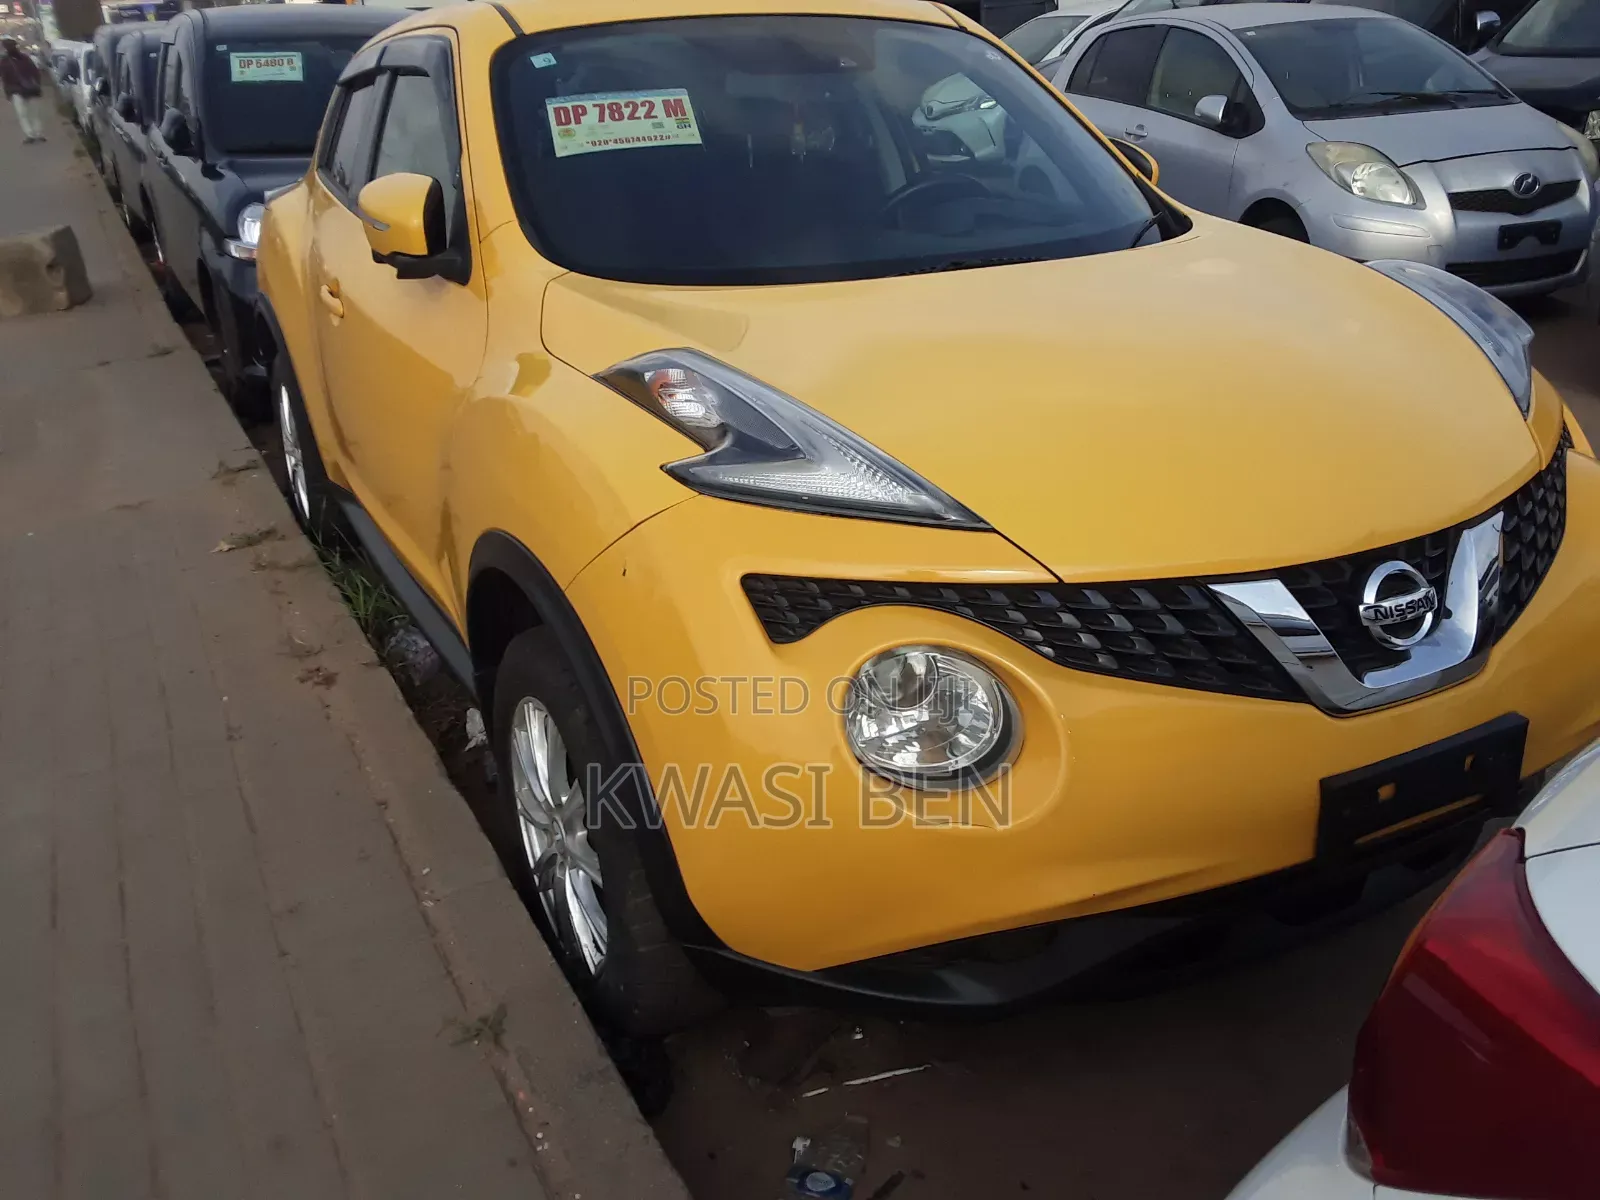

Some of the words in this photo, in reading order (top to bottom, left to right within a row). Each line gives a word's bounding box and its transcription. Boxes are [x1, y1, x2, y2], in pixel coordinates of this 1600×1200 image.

[239, 59, 254, 69] DP
[553, 104, 588, 126] DP
[592, 100, 658, 123] 7822
[662, 98, 687, 118] M
[1374, 590, 1435, 621] NISSAN
